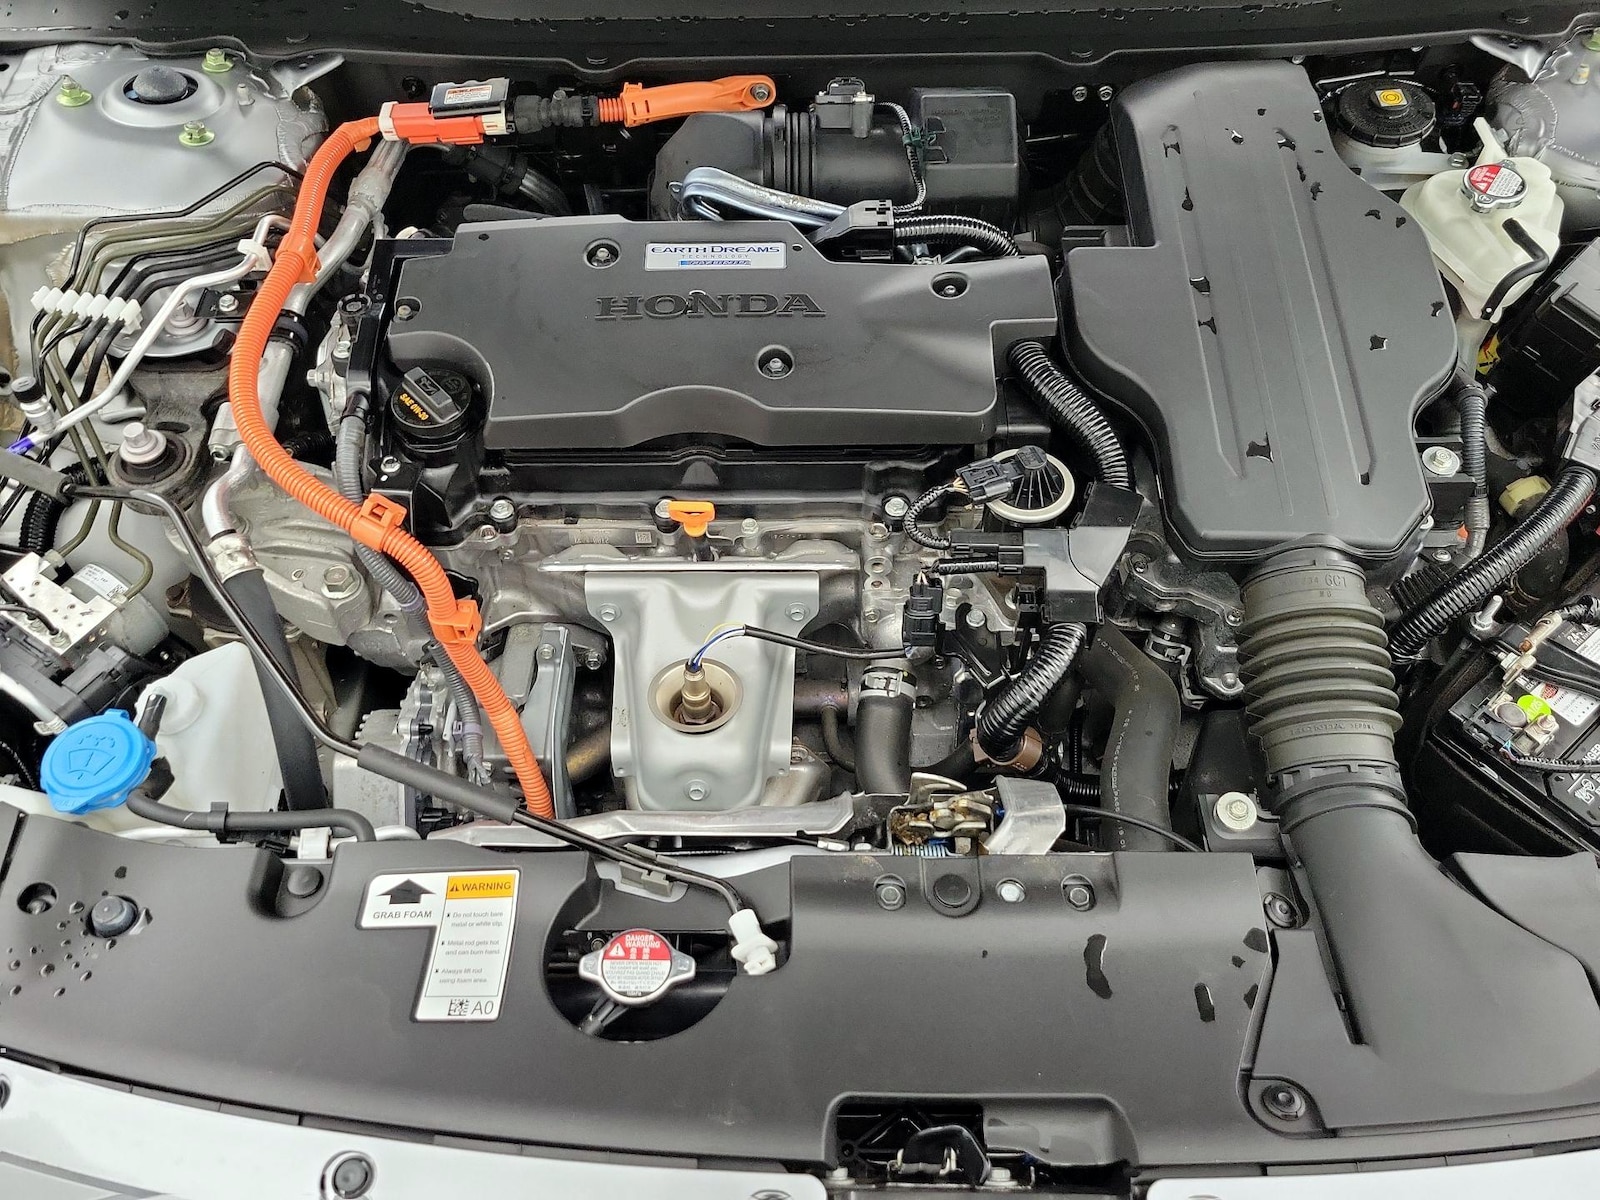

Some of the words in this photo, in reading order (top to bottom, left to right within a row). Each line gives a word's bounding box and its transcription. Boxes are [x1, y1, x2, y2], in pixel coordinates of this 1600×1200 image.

[651, 246, 707, 254] EARTH
[711, 245, 780, 253] DREAMS
[594, 292, 827, 321] HONDA
[399, 393, 415, 407] SAE
[461, 881, 512, 891] WARNING
[373, 911, 401, 919] GRAB
[403, 910, 433, 919] FOAM
[471, 1000, 494, 1015] A0
